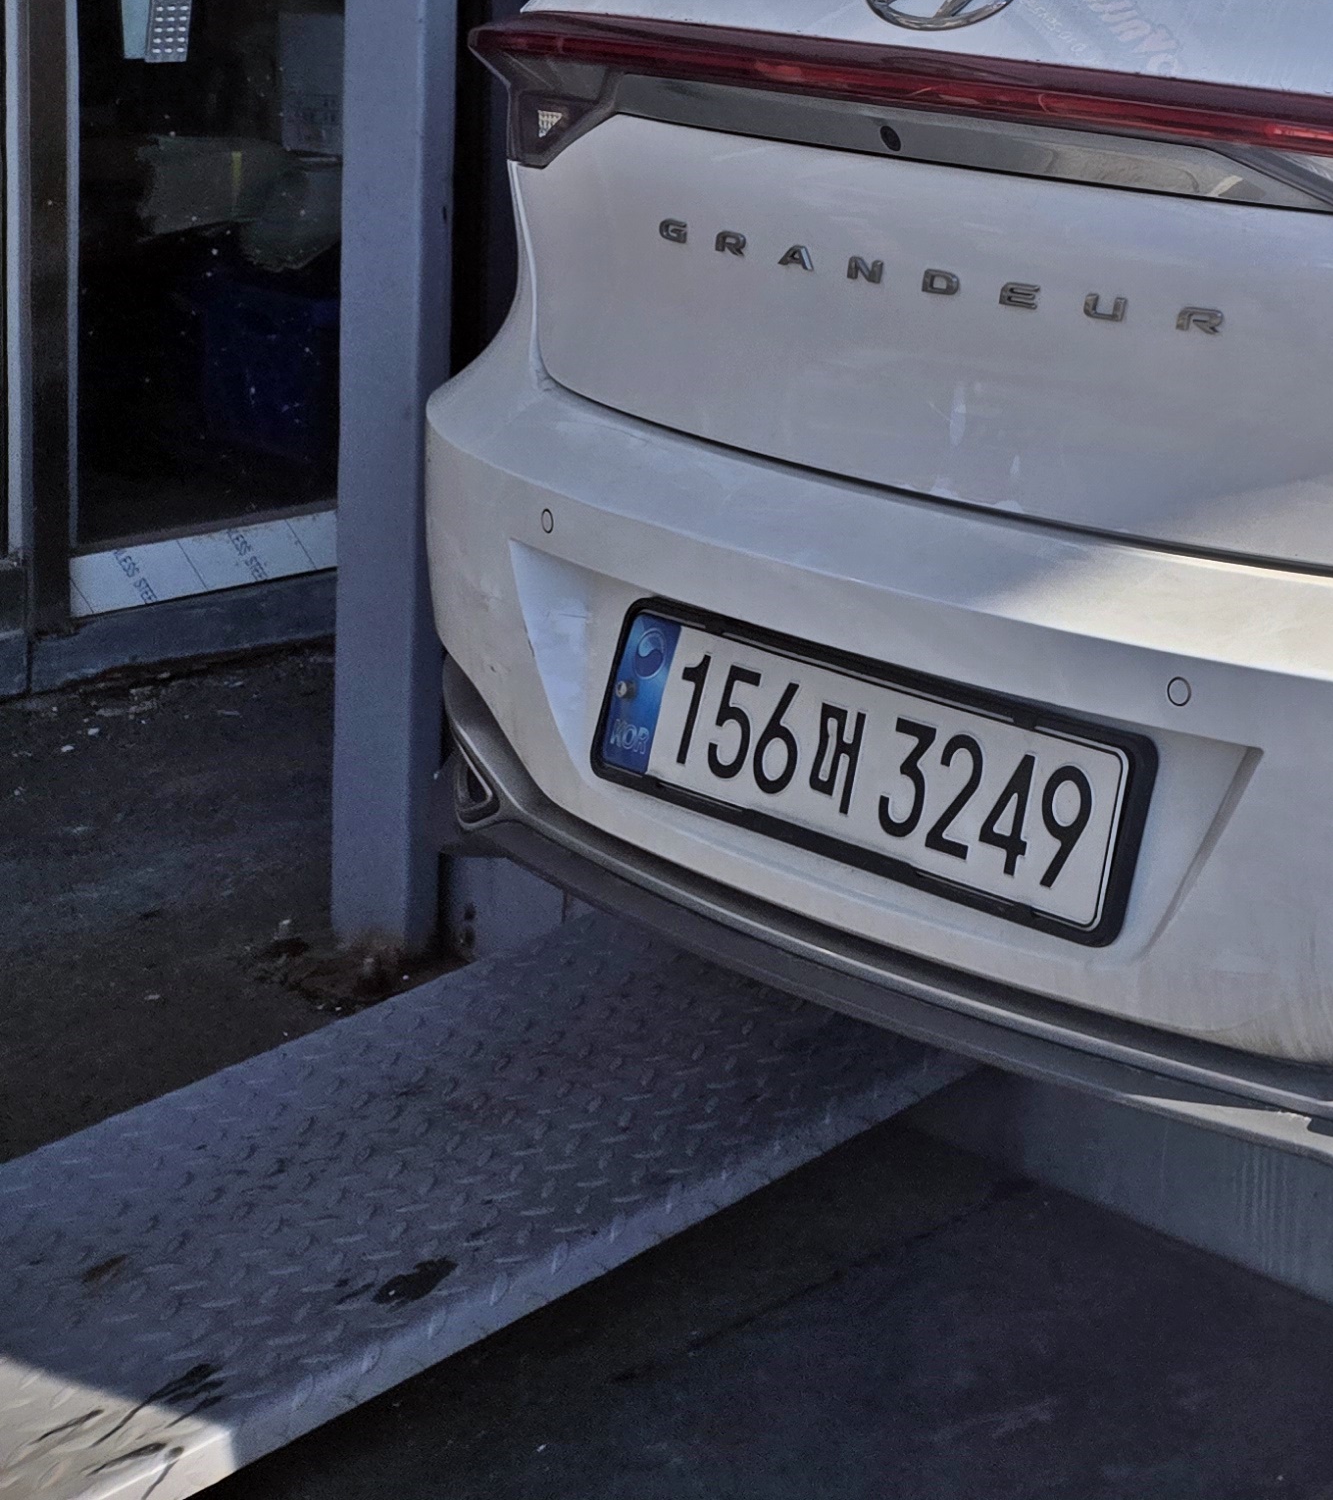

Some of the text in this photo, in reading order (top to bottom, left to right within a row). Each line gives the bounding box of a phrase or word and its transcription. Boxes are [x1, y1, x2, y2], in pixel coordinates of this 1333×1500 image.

[658, 217, 1225, 336] GRANDEUR
[610, 718, 650, 755] KOR
[877, 716, 1093, 889] 3249
